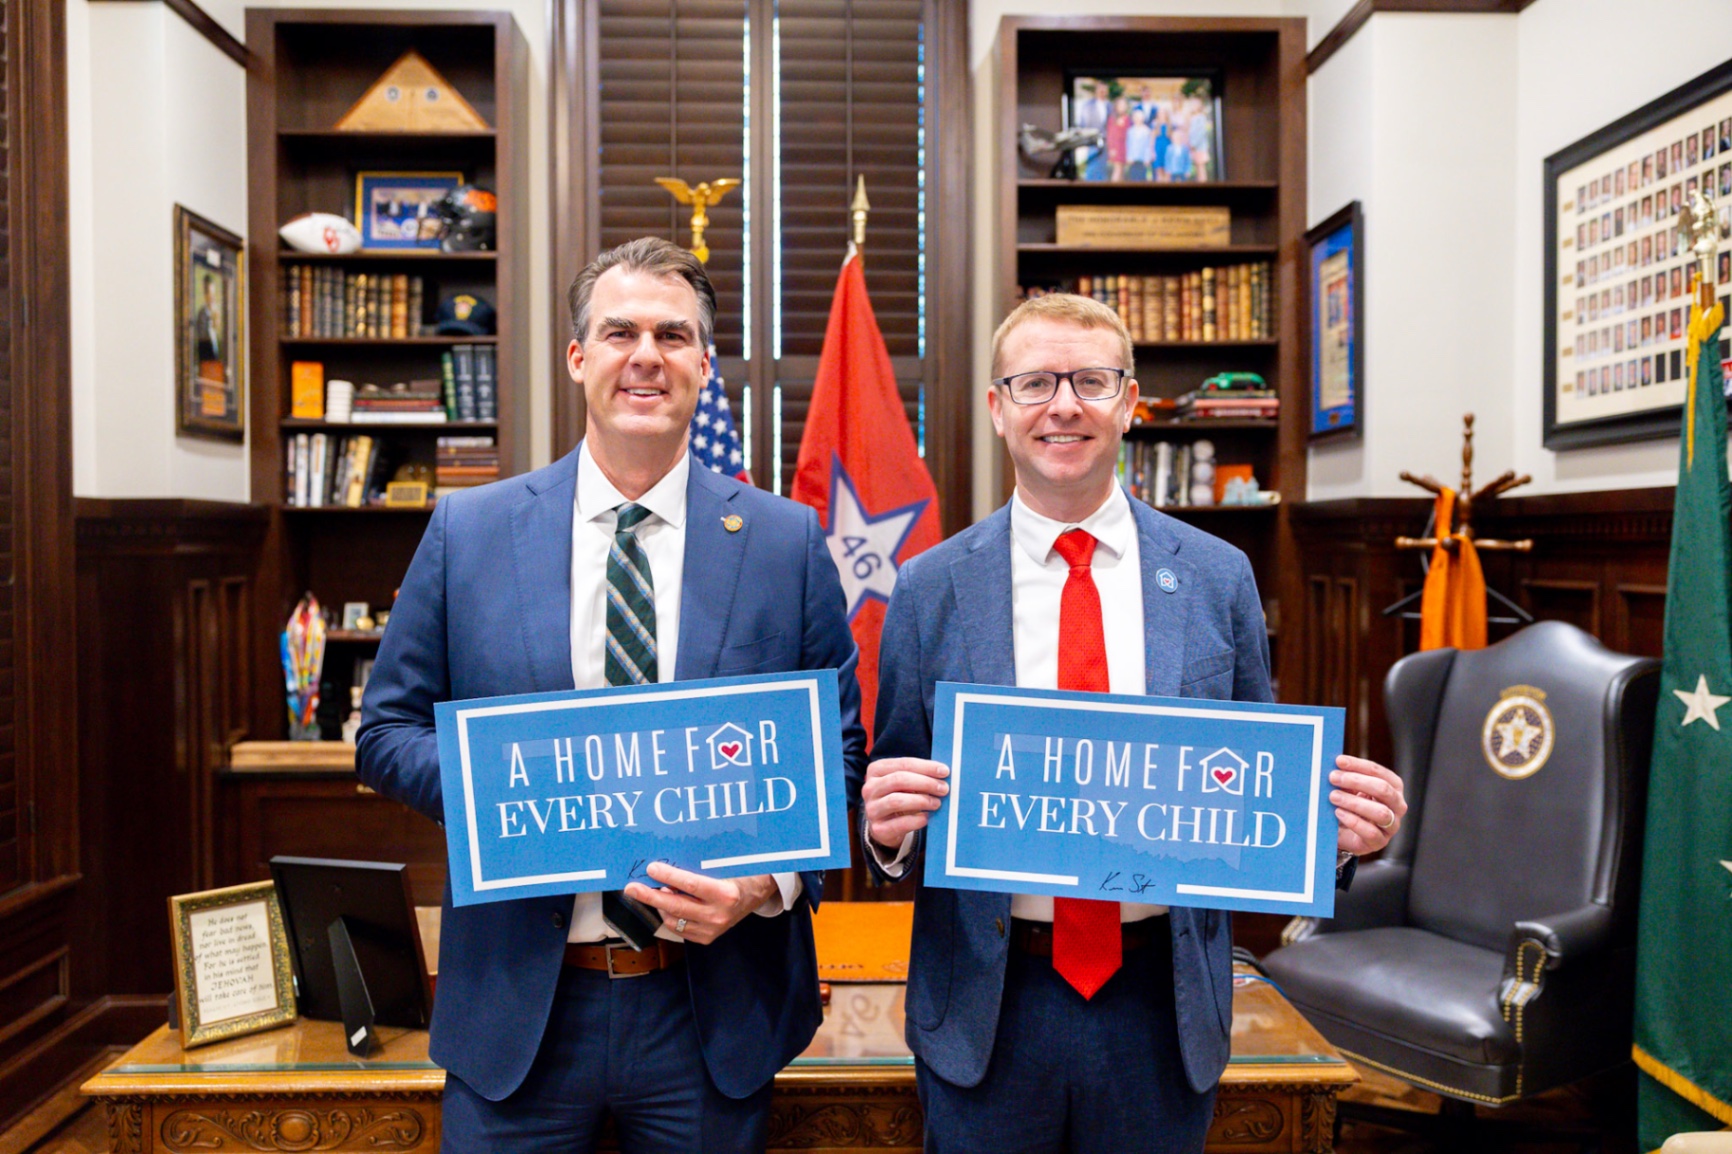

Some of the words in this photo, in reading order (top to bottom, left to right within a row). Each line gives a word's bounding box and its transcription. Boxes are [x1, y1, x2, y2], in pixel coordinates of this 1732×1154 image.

[841, 535, 882, 580] 46
[509, 742, 530, 788] A
[553, 729, 669, 783] HOME
[995, 733, 1016, 780] A
[1043, 736, 1159, 790] HOME
[496, 790, 644, 838] EVERY
[653, 776, 798, 825] CHILD
[978, 791, 1129, 837] EVERY
[1137, 802, 1287, 849] CHILD
